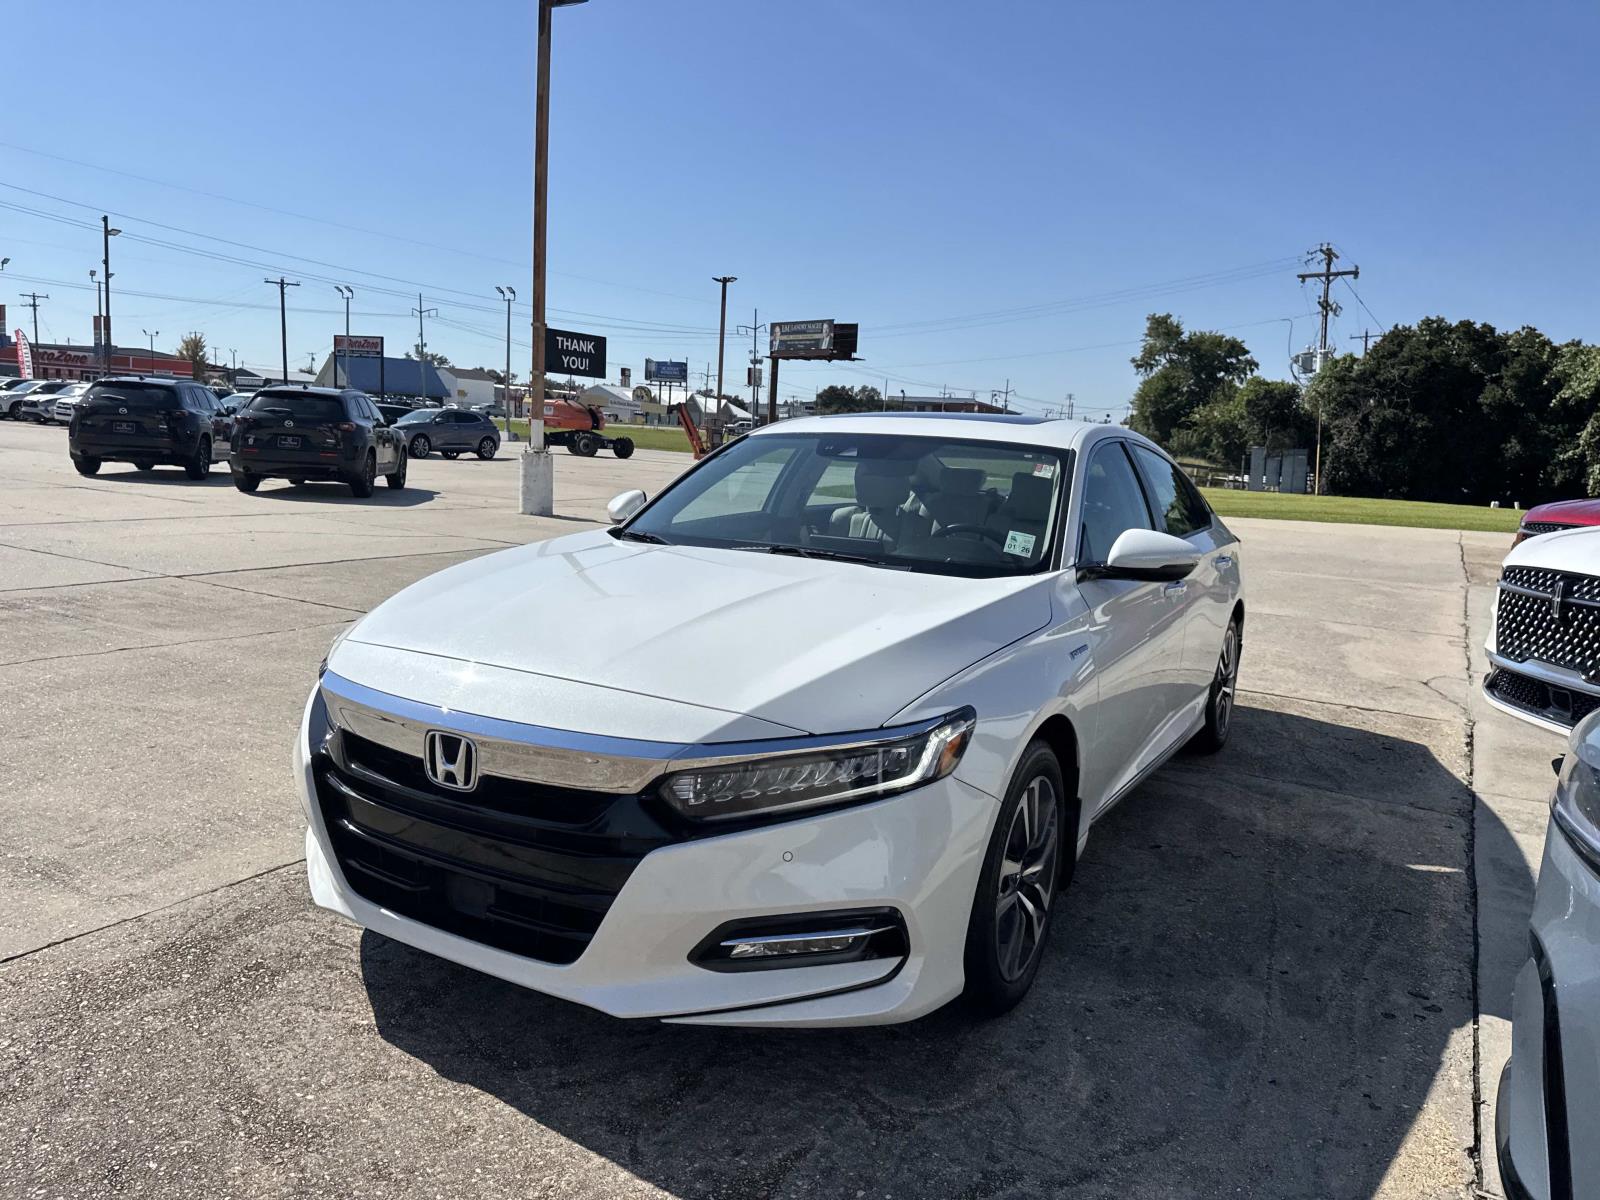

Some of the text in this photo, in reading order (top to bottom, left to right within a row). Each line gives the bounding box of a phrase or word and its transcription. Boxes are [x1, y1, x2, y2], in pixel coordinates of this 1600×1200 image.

[556, 336, 595, 354] THANK
[32, 348, 88, 365] toZone
[561, 354, 589, 371] YOU!
[1020, 545, 1031, 555] 26
